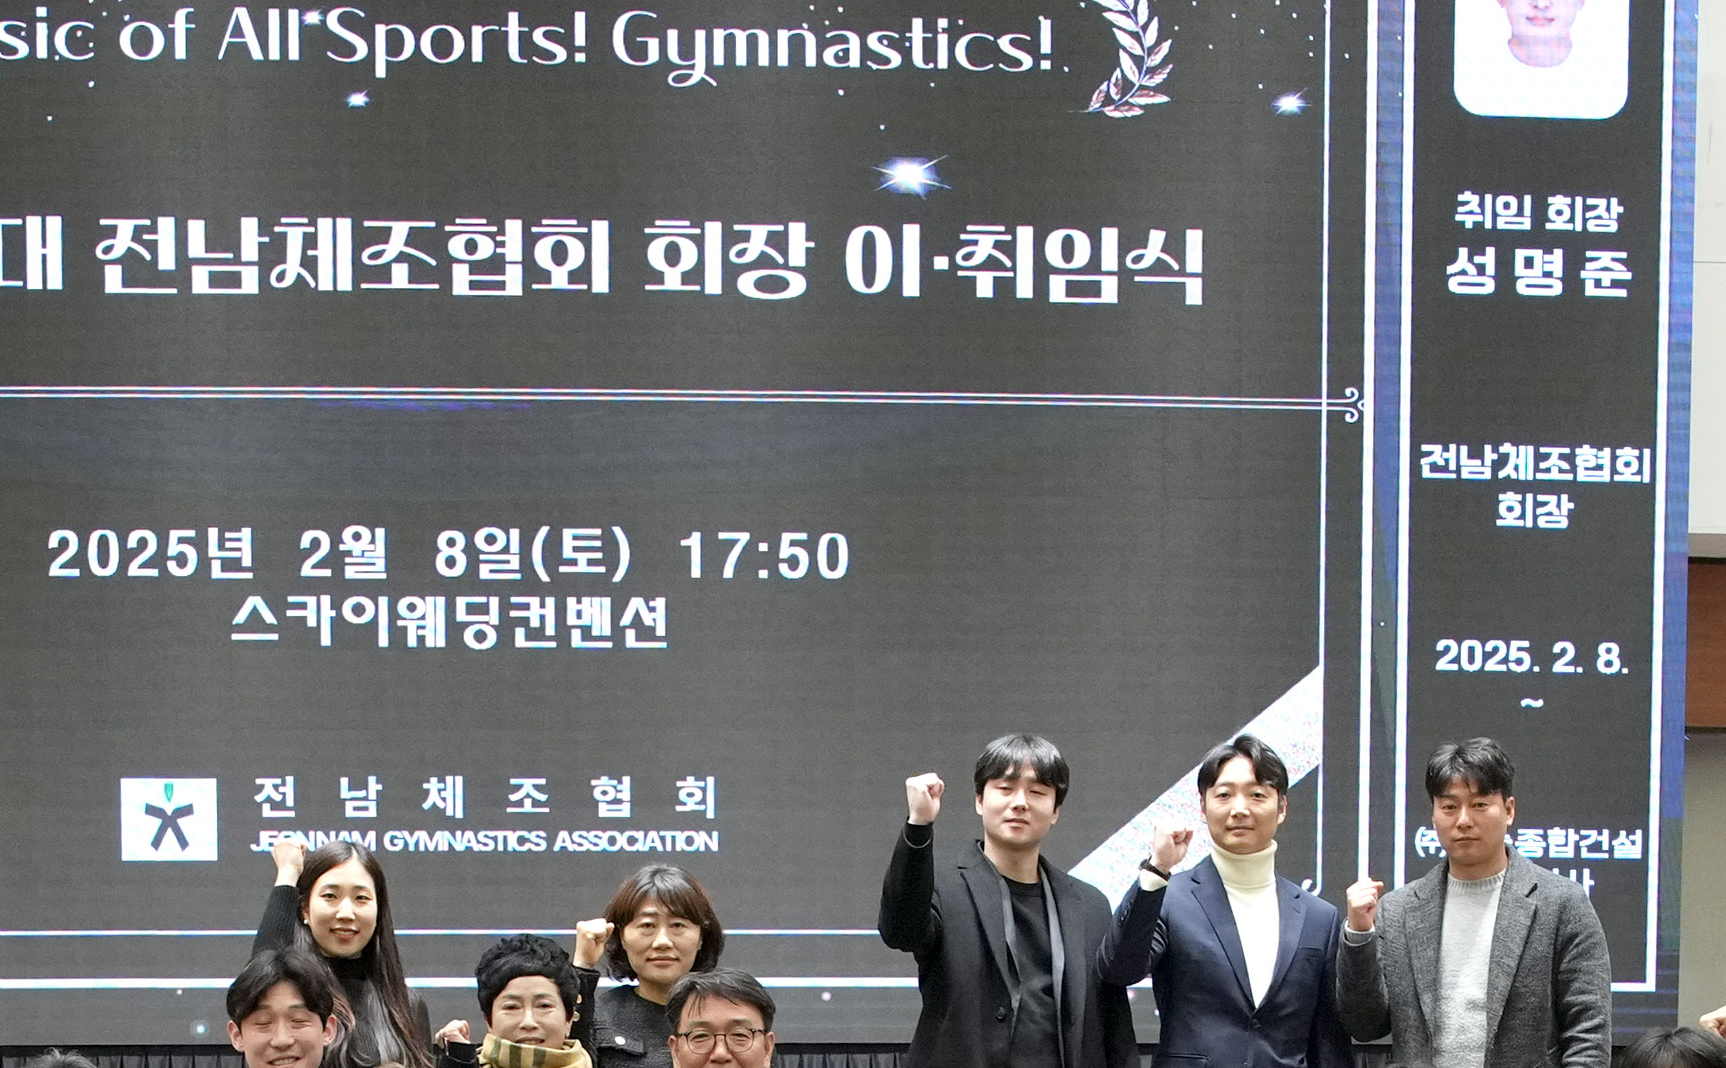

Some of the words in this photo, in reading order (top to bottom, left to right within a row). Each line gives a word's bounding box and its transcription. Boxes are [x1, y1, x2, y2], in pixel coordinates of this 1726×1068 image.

[119, 8, 195, 60] of
[218, 7, 299, 60] All
[326, 7, 585, 78] Sports!
[613, 9, 1052, 87] Gymnastics!
[1455, 191, 1531, 230] 취임
[1545, 195, 1624, 232] 회장
[96, 217, 609, 296] 전남체조협회
[644, 220, 815, 300] 회장
[1420, 443, 1650, 483] 전남체조협회
[1496, 492, 1574, 528] 회장
[48, 527, 253, 579] 2025년
[300, 525, 387, 579] 2월
[436, 526, 630, 582] 8일(토)
[680, 532, 848, 579] 17:50
[231, 595, 667, 650] 스카이웨딩컨벤션
[1436, 639, 1539, 673] 2025.
[1552, 641, 1583, 673] 2.
[1597, 642, 1628, 674] 8.
[383, 830, 547, 851] GYMNASTICS
[553, 830, 718, 852] ASSOCIATION
